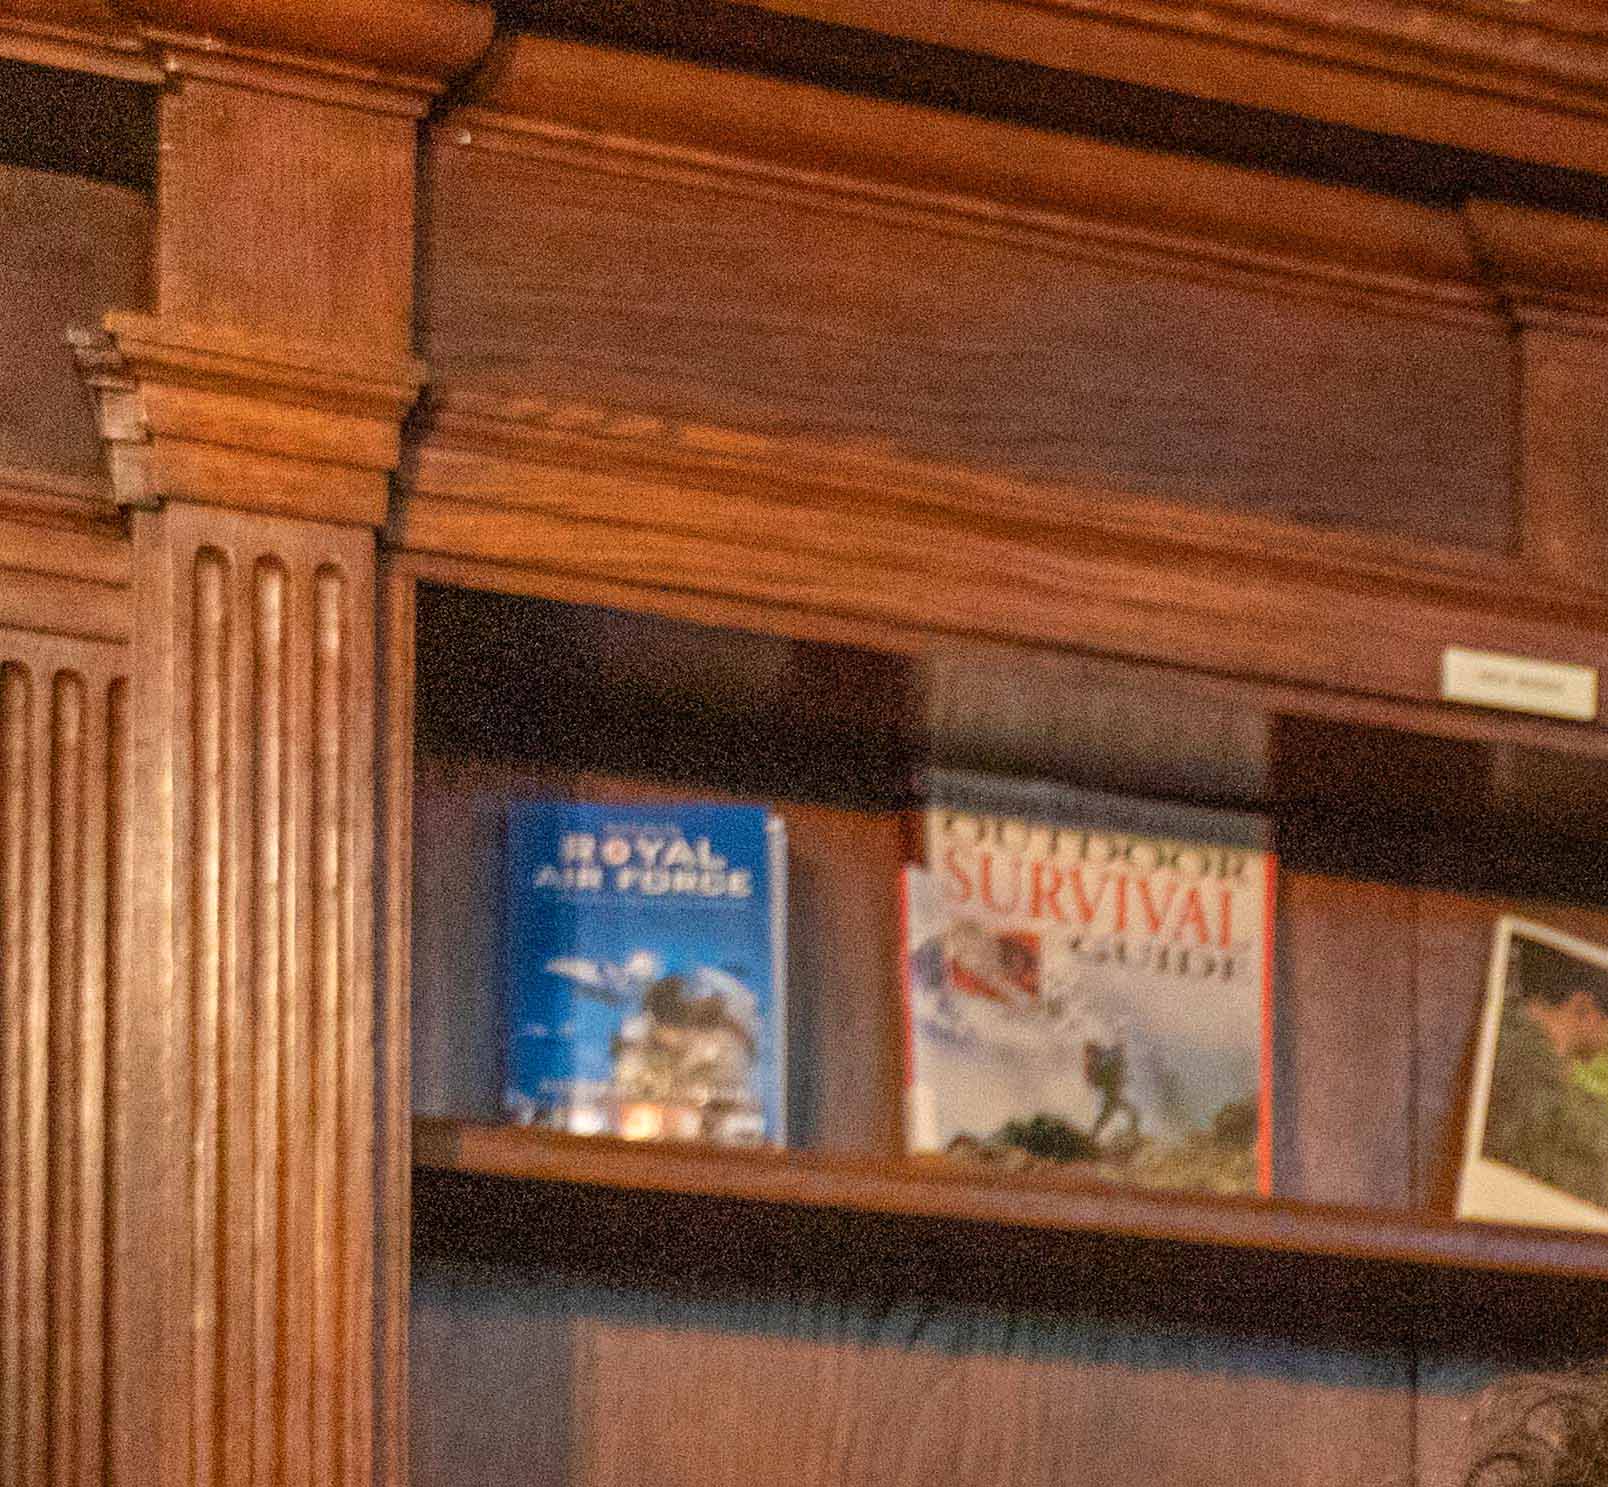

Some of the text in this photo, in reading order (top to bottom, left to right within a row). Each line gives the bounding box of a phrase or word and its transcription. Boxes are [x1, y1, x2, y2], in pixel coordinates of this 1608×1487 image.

[559, 834, 728, 871] ROYAL
[533, 866, 751, 897] AIR FORCE
[942, 848, 1234, 950] SURVIVAL
[1068, 935, 1238, 980] GUIDE
